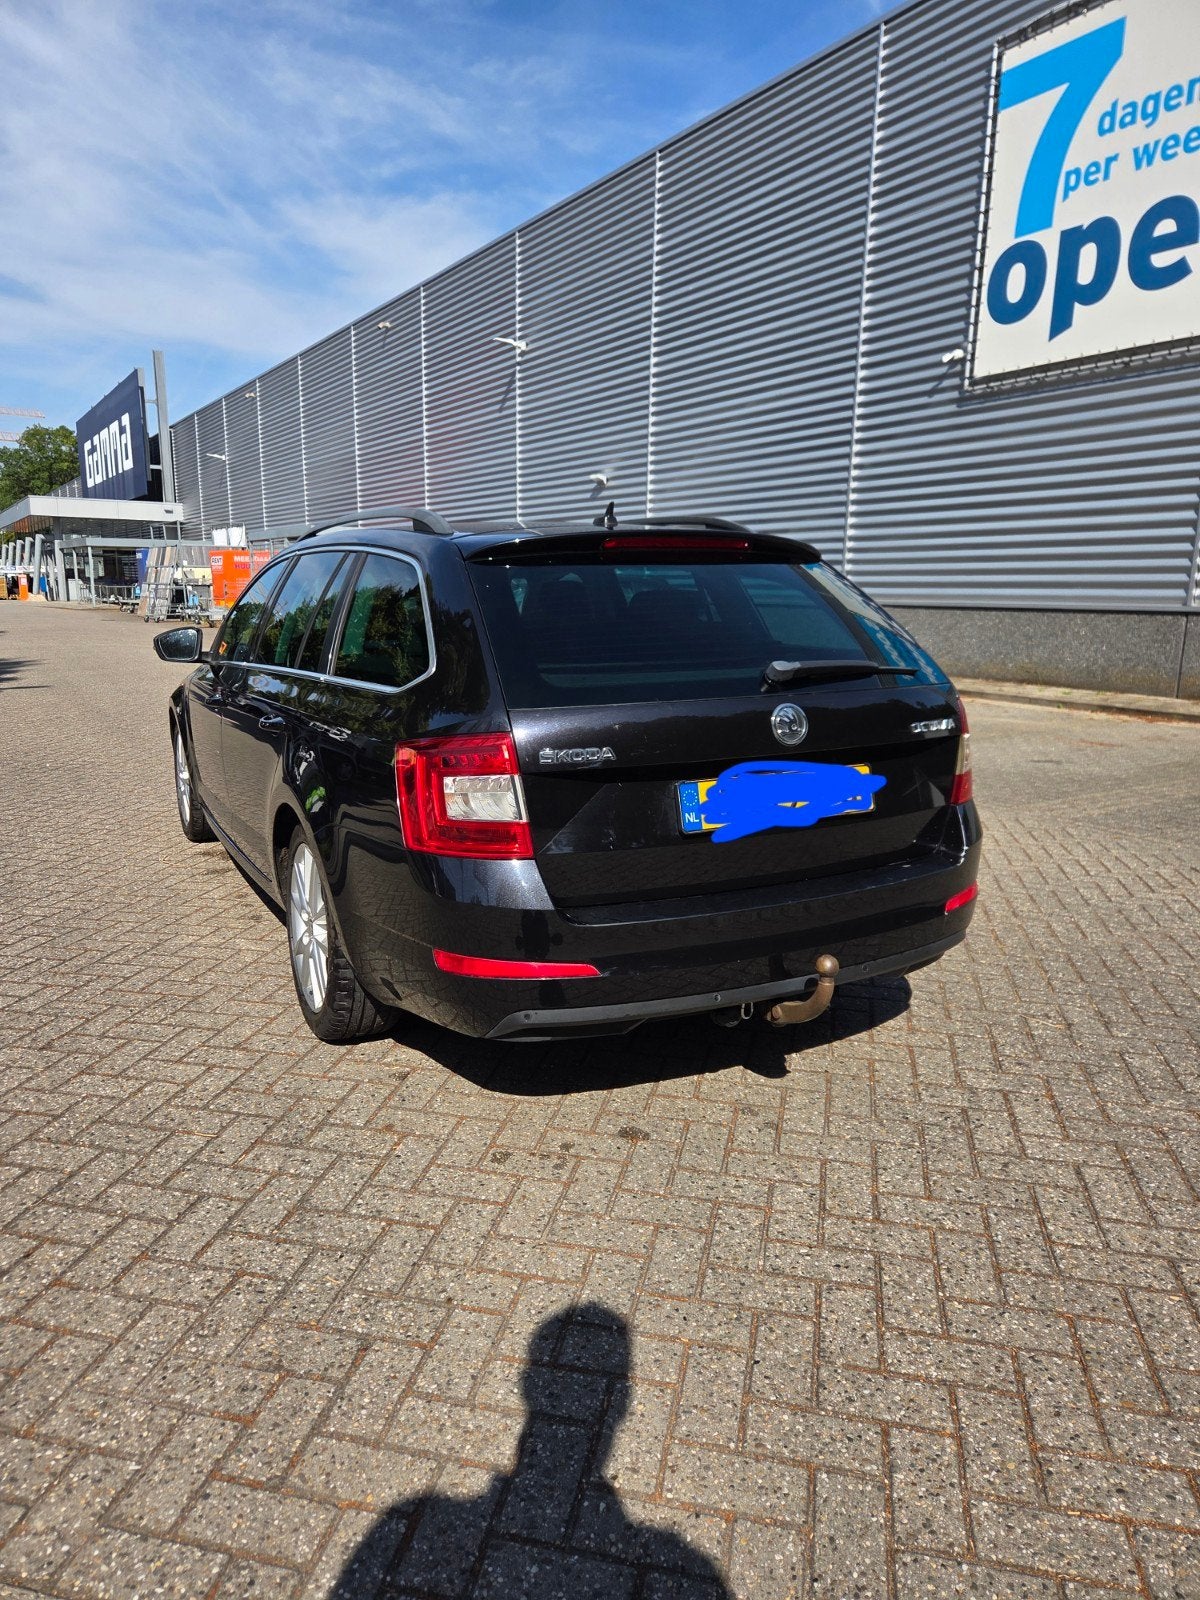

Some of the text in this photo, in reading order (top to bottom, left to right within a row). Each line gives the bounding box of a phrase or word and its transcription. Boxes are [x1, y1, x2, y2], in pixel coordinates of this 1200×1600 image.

[998, 15, 1127, 239] 7
[1062, 152, 1120, 203] per
[986, 194, 1200, 342] ope
[539, 747, 616, 764] ŠKODA
[685, 812, 700, 823] NL
